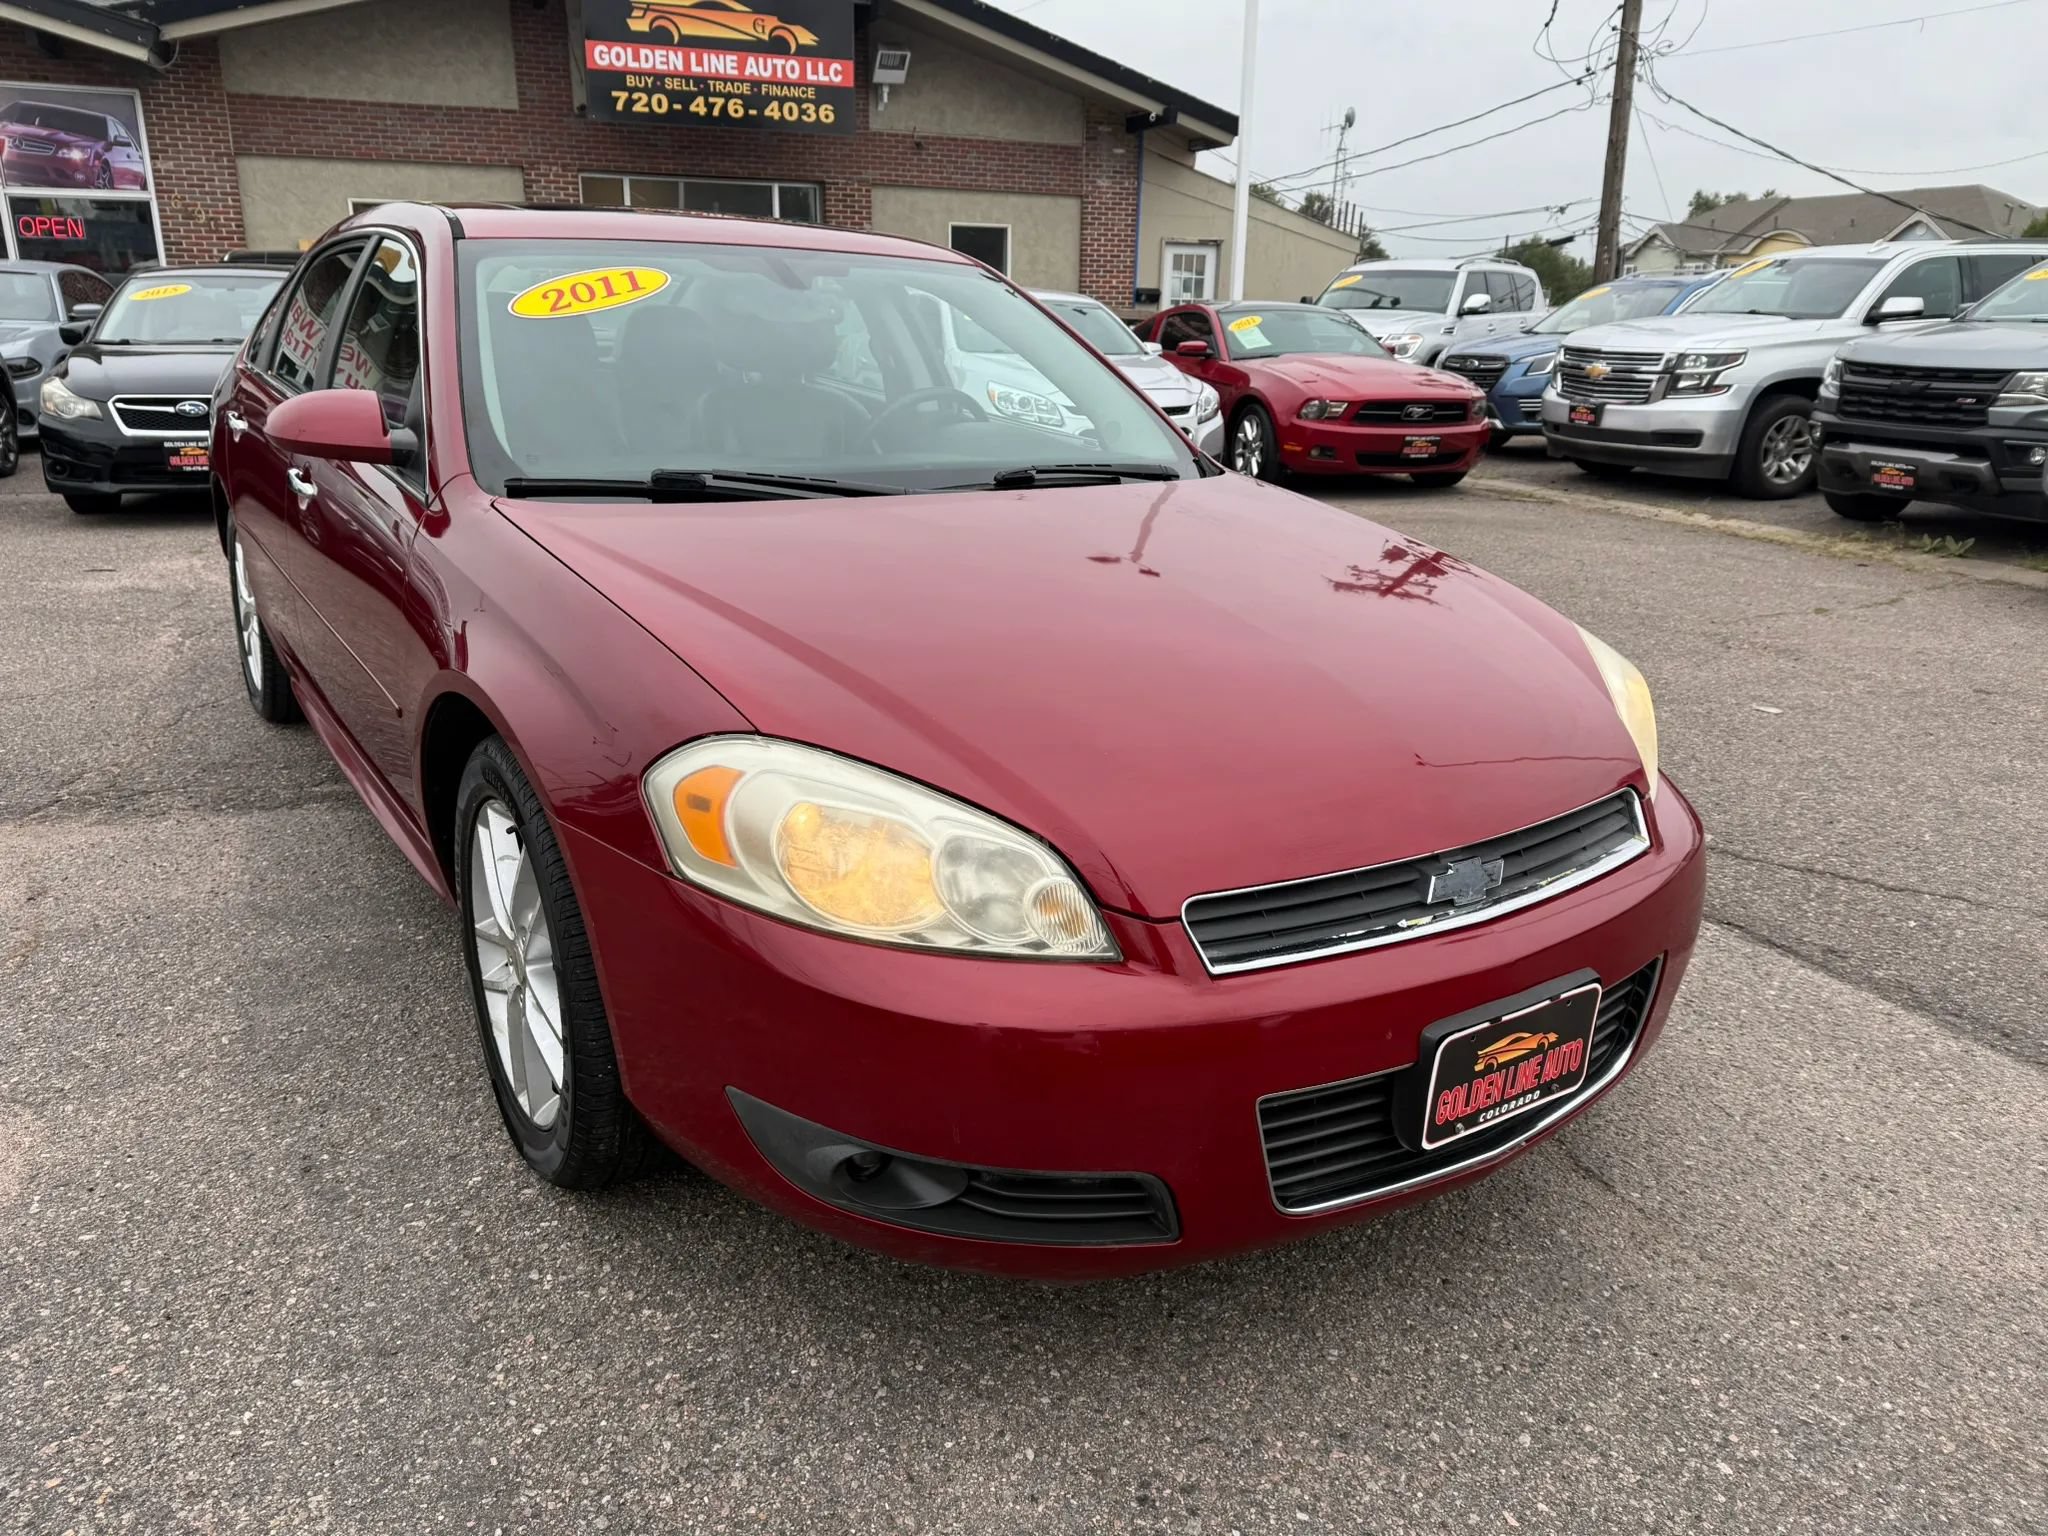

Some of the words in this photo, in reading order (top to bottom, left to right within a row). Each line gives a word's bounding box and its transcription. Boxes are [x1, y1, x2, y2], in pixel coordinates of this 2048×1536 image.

[593, 44, 683, 72] GOLDEN
[690, 51, 739, 76] LINE
[744, 56, 801, 81] AUTO
[806, 61, 843, 83] LLC
[626, 74, 654, 89] BUY
[664, 77, 698, 92] SELL
[707, 80, 752, 96] TRADE
[761, 84, 816, 100] FINANCE
[18, 216, 85, 240] OPEN
[541, 270, 647, 313] 2011
[1435, 1070, 1505, 1126] GOLDEN
[1504, 1053, 1544, 1099] LINE
[1540, 1037, 1584, 1084] AUTO
[1478, 1090, 1541, 1123] COLORADO
